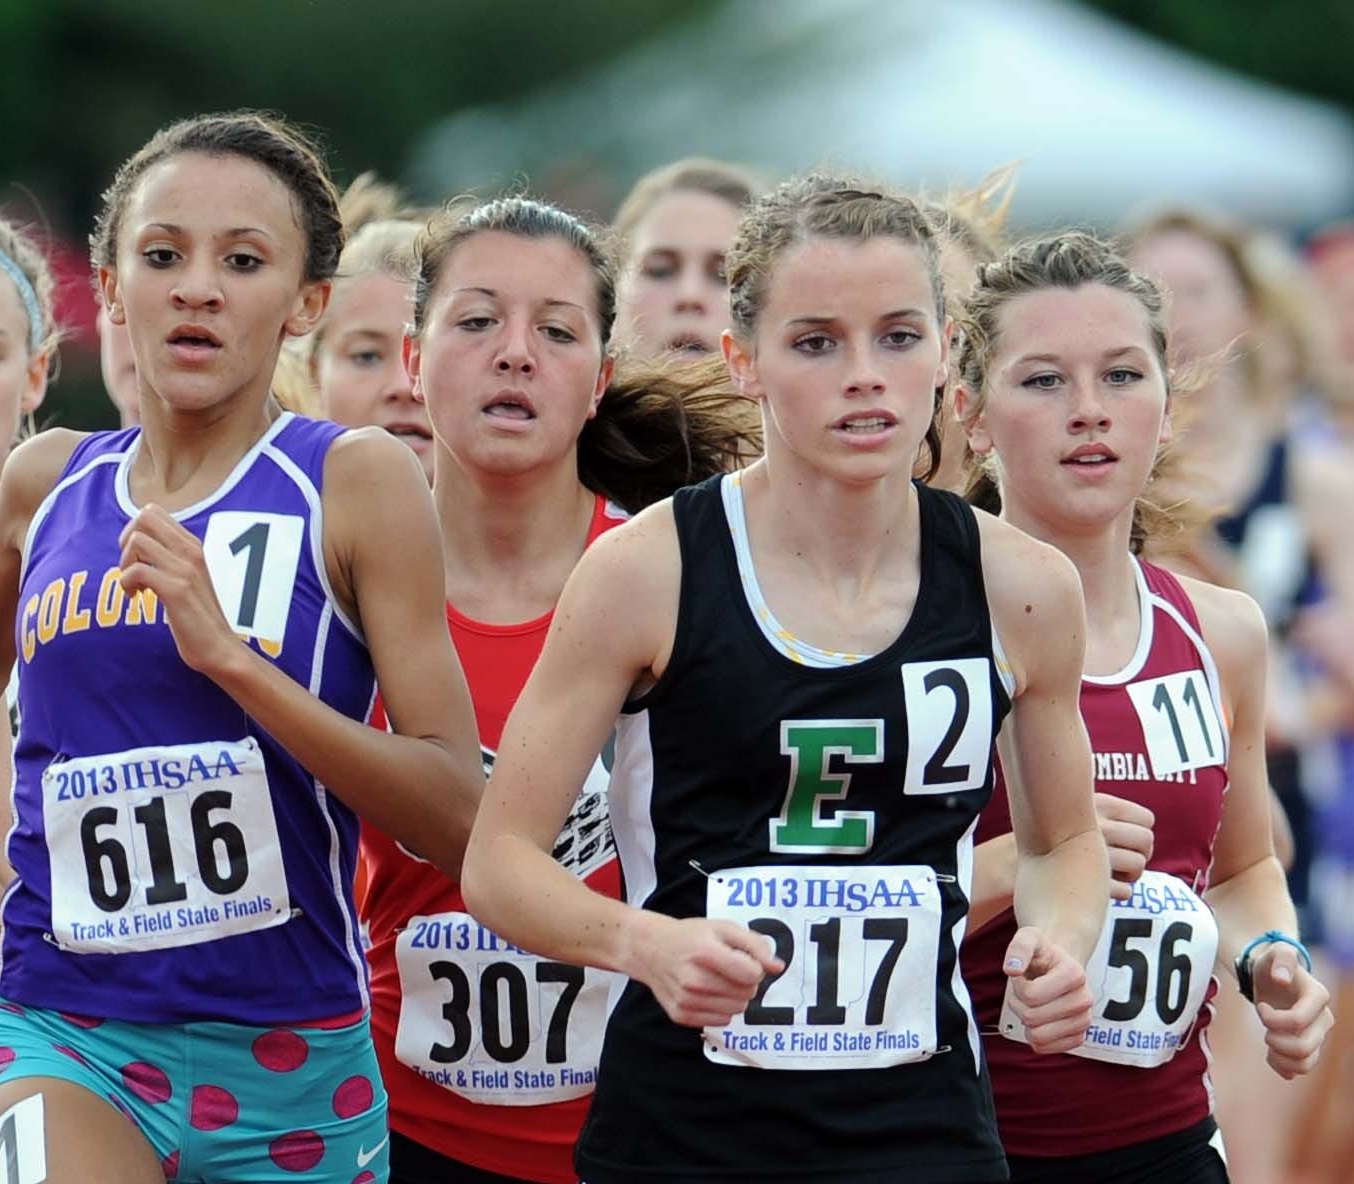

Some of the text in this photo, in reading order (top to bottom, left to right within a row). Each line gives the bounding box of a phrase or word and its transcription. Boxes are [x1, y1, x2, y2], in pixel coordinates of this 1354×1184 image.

[229, 522, 270, 628] 1
[922, 667, 970, 785] 2
[1152, 677, 1214, 763] 11
[56, 751, 246, 801] 2013 IHSAA
[769, 719, 885, 854] E
[80, 790, 249, 912] 616
[71, 896, 272, 941] Track & Field State Finals
[727, 878, 926, 912] 2013 IHSAA
[411, 922, 470, 951] 2013
[744, 917, 909, 1026] 217
[429, 961, 585, 1064] 307
[723, 1029, 920, 1051] Track & Field State Finals
[1085, 1025, 1122, 1046] Field
[1127, 1030, 1161, 1049] State
[456, 1069, 467, 1087] &
[472, 1069, 509, 1089] Field
[514, 1069, 556, 1089] State
[560, 1066, 597, 1086] Final
